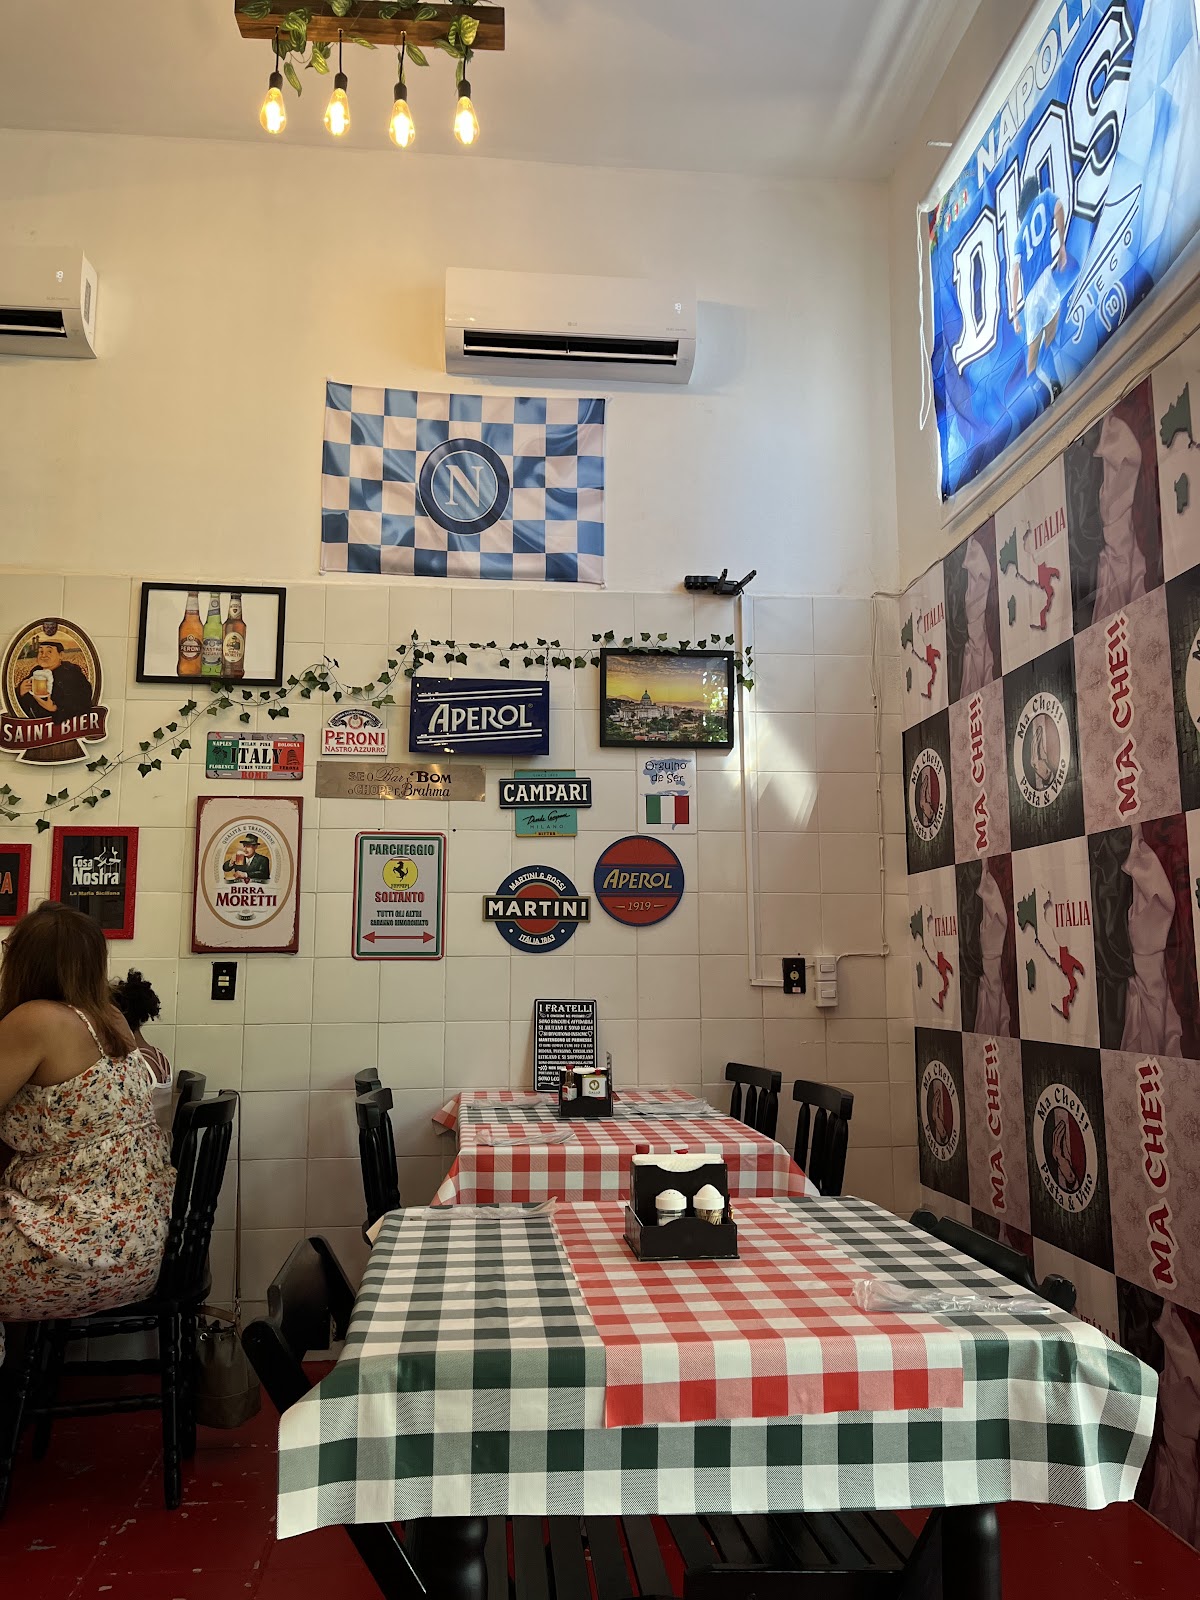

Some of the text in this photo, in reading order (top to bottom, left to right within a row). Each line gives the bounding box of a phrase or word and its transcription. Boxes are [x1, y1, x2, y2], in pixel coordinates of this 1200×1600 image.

[1021, 203, 1048, 260] 10
[445, 464, 484, 507] N
[1033, 507, 1066, 550] ITÁLIA
[923, 602, 945, 633] ITÁLIA
[3, 712, 100, 743] SAINT BIER
[428, 703, 533, 733] APEROL
[1017, 714, 1031, 739] Ma
[325, 730, 385, 745] PERONI
[231, 747, 283, 764] ITALY
[241, 771, 268, 779] ROME
[651, 773, 684, 784] de Ser
[1020, 776, 1041, 806] Pasta
[1050, 759, 1066, 795] Vino
[1115, 739, 1139, 816] MA
[503, 784, 588, 802] CAMPARI
[974, 793, 988, 852] MA
[248, 825, 275, 845] TRADIZIONE
[369, 843, 435, 856] PARCHEGGIO
[72, 855, 93, 867] Cosa
[71, 867, 119, 885] Nostra
[508, 872, 538, 891] MARTINI
[546, 873, 567, 891] ROSSI
[602, 868, 673, 889] APEROL
[215, 892, 277, 907] MORETTI
[230, 886, 264, 894] BIRRA
[375, 891, 425, 902] SOLTANTO
[488, 900, 587, 917] MARTINI
[627, 901, 652, 911] 1919
[1054, 899, 1091, 928] ITÁLIA
[934, 914, 957, 937] ITÁLIA
[545, 1004, 592, 1013] FRATELLI
[1036, 1099, 1051, 1121] Ma
[990, 1150, 1007, 1209] MA
[1040, 1161, 1064, 1206] Pasta
[1076, 1173, 1093, 1206] Vino
[1148, 1204, 1176, 1285] MA
